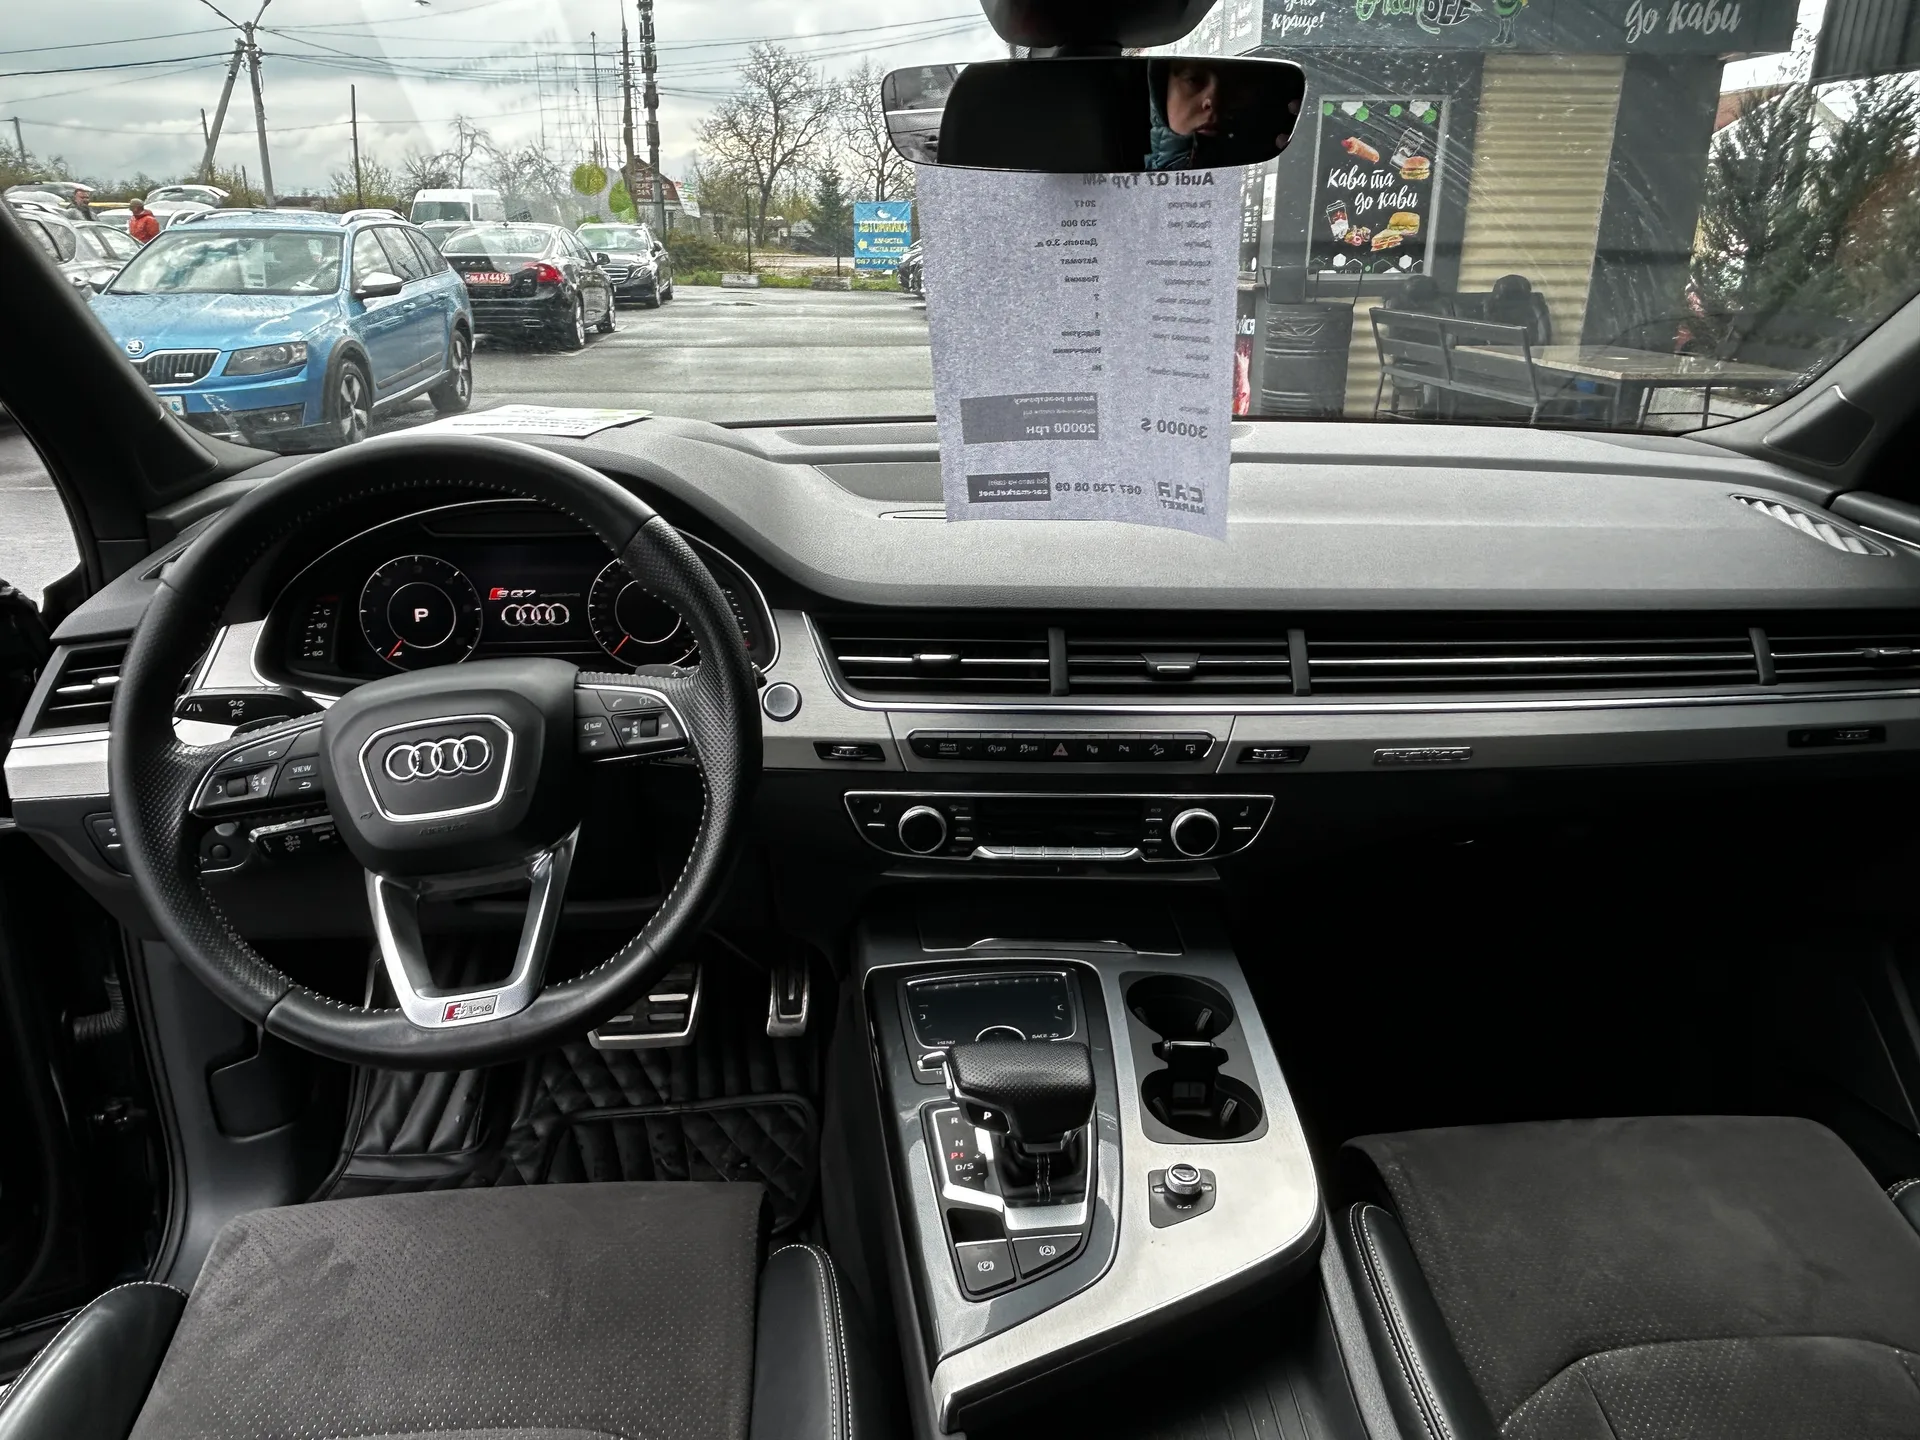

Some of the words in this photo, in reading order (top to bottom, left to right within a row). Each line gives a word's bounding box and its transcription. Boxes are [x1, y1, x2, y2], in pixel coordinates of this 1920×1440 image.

[1271, 11, 1326, 38] краще!
[1326, 165, 1368, 190] Кава
[1371, 169, 1396, 189] та
[1355, 193, 1374, 215] до
[1377, 185, 1418, 210] кави
[414, 607, 429, 622] P
[292, 764, 312, 774] VIEW
[983, 1111, 993, 1120] P
[955, 1162, 974, 1171] D/S
